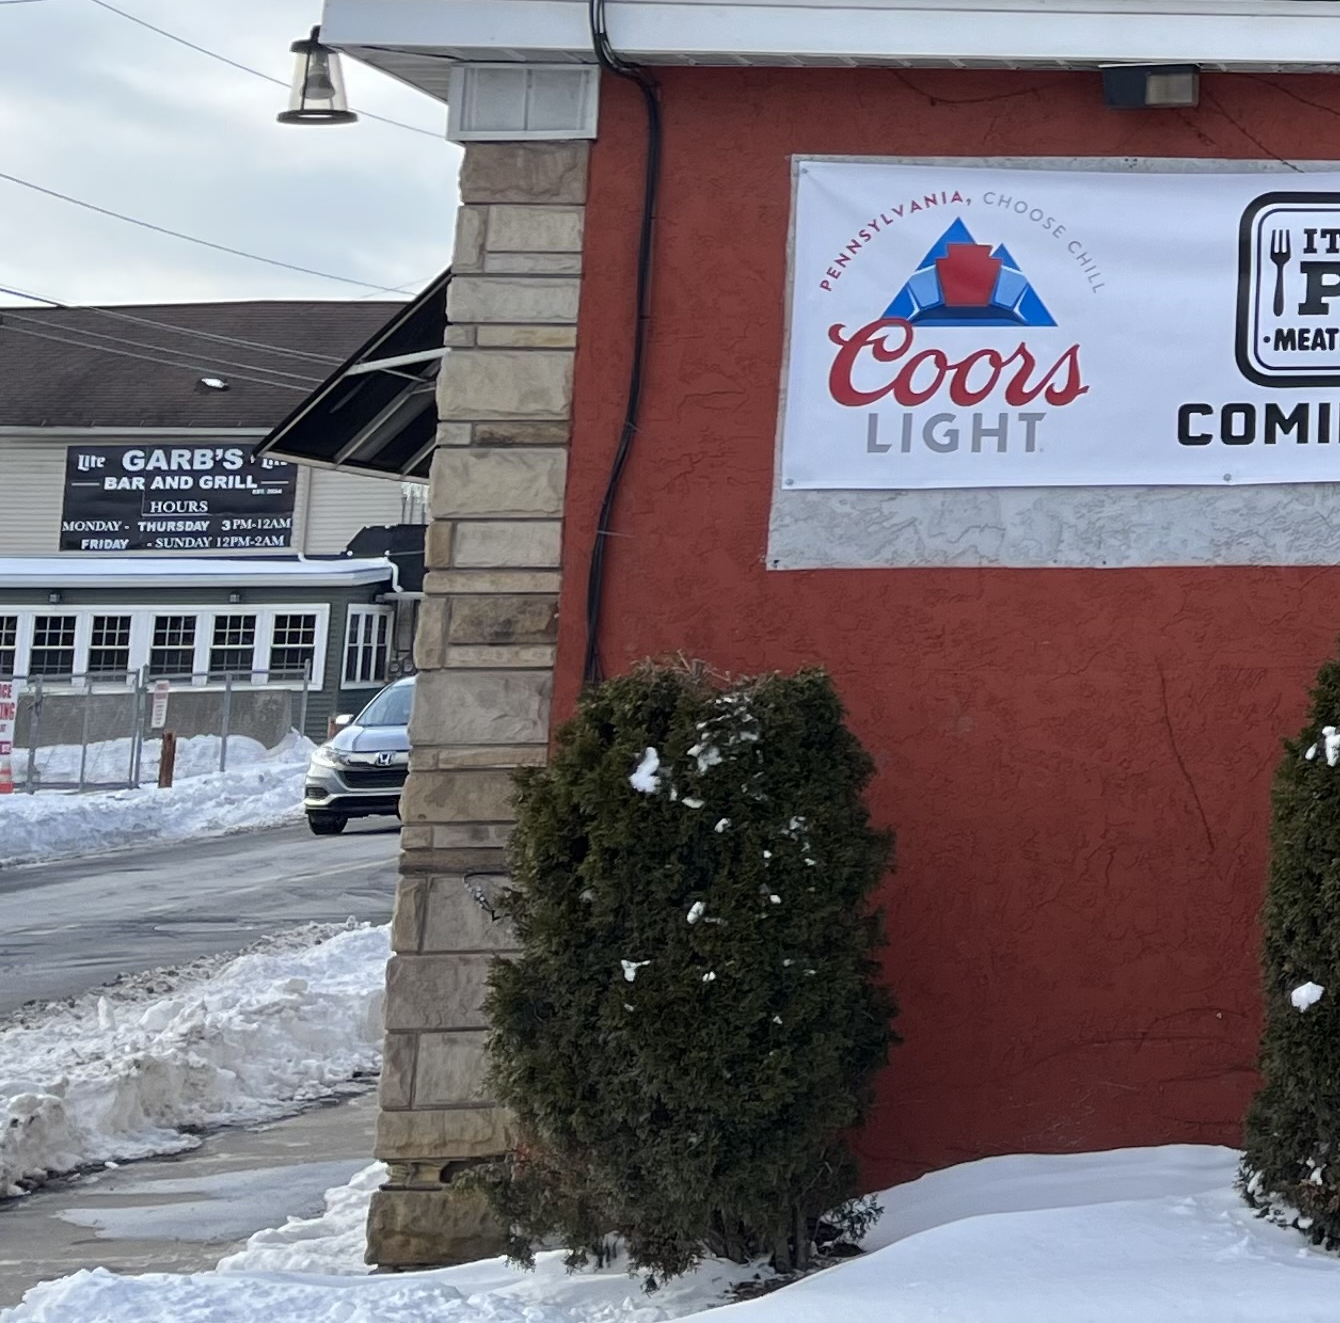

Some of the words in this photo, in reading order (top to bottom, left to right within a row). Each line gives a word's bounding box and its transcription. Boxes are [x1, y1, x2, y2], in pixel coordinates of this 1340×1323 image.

[820, 190, 972, 292] PENNSYLVANIA,
[983, 191, 1067, 239] CHOOSE
[1066, 240, 1106, 294] CHILL
[828, 317, 1090, 407] Coors
[866, 412, 1047, 453] LIGHT
[77, 454, 106, 471] Lite
[122, 448, 243, 471] GARB'S
[104, 476, 145, 490] BAR
[151, 476, 193, 489] AND
[199, 475, 258, 489] GRILL
[150, 501, 208, 513] HOURS
[62, 521, 122, 532] MONDAY
[138, 521, 210, 532] THURSDAY
[81, 539, 129, 550] FRIDAY
[155, 536, 212, 548] SUNDAY
[216, 535, 285, 548] 12PM-2AM
